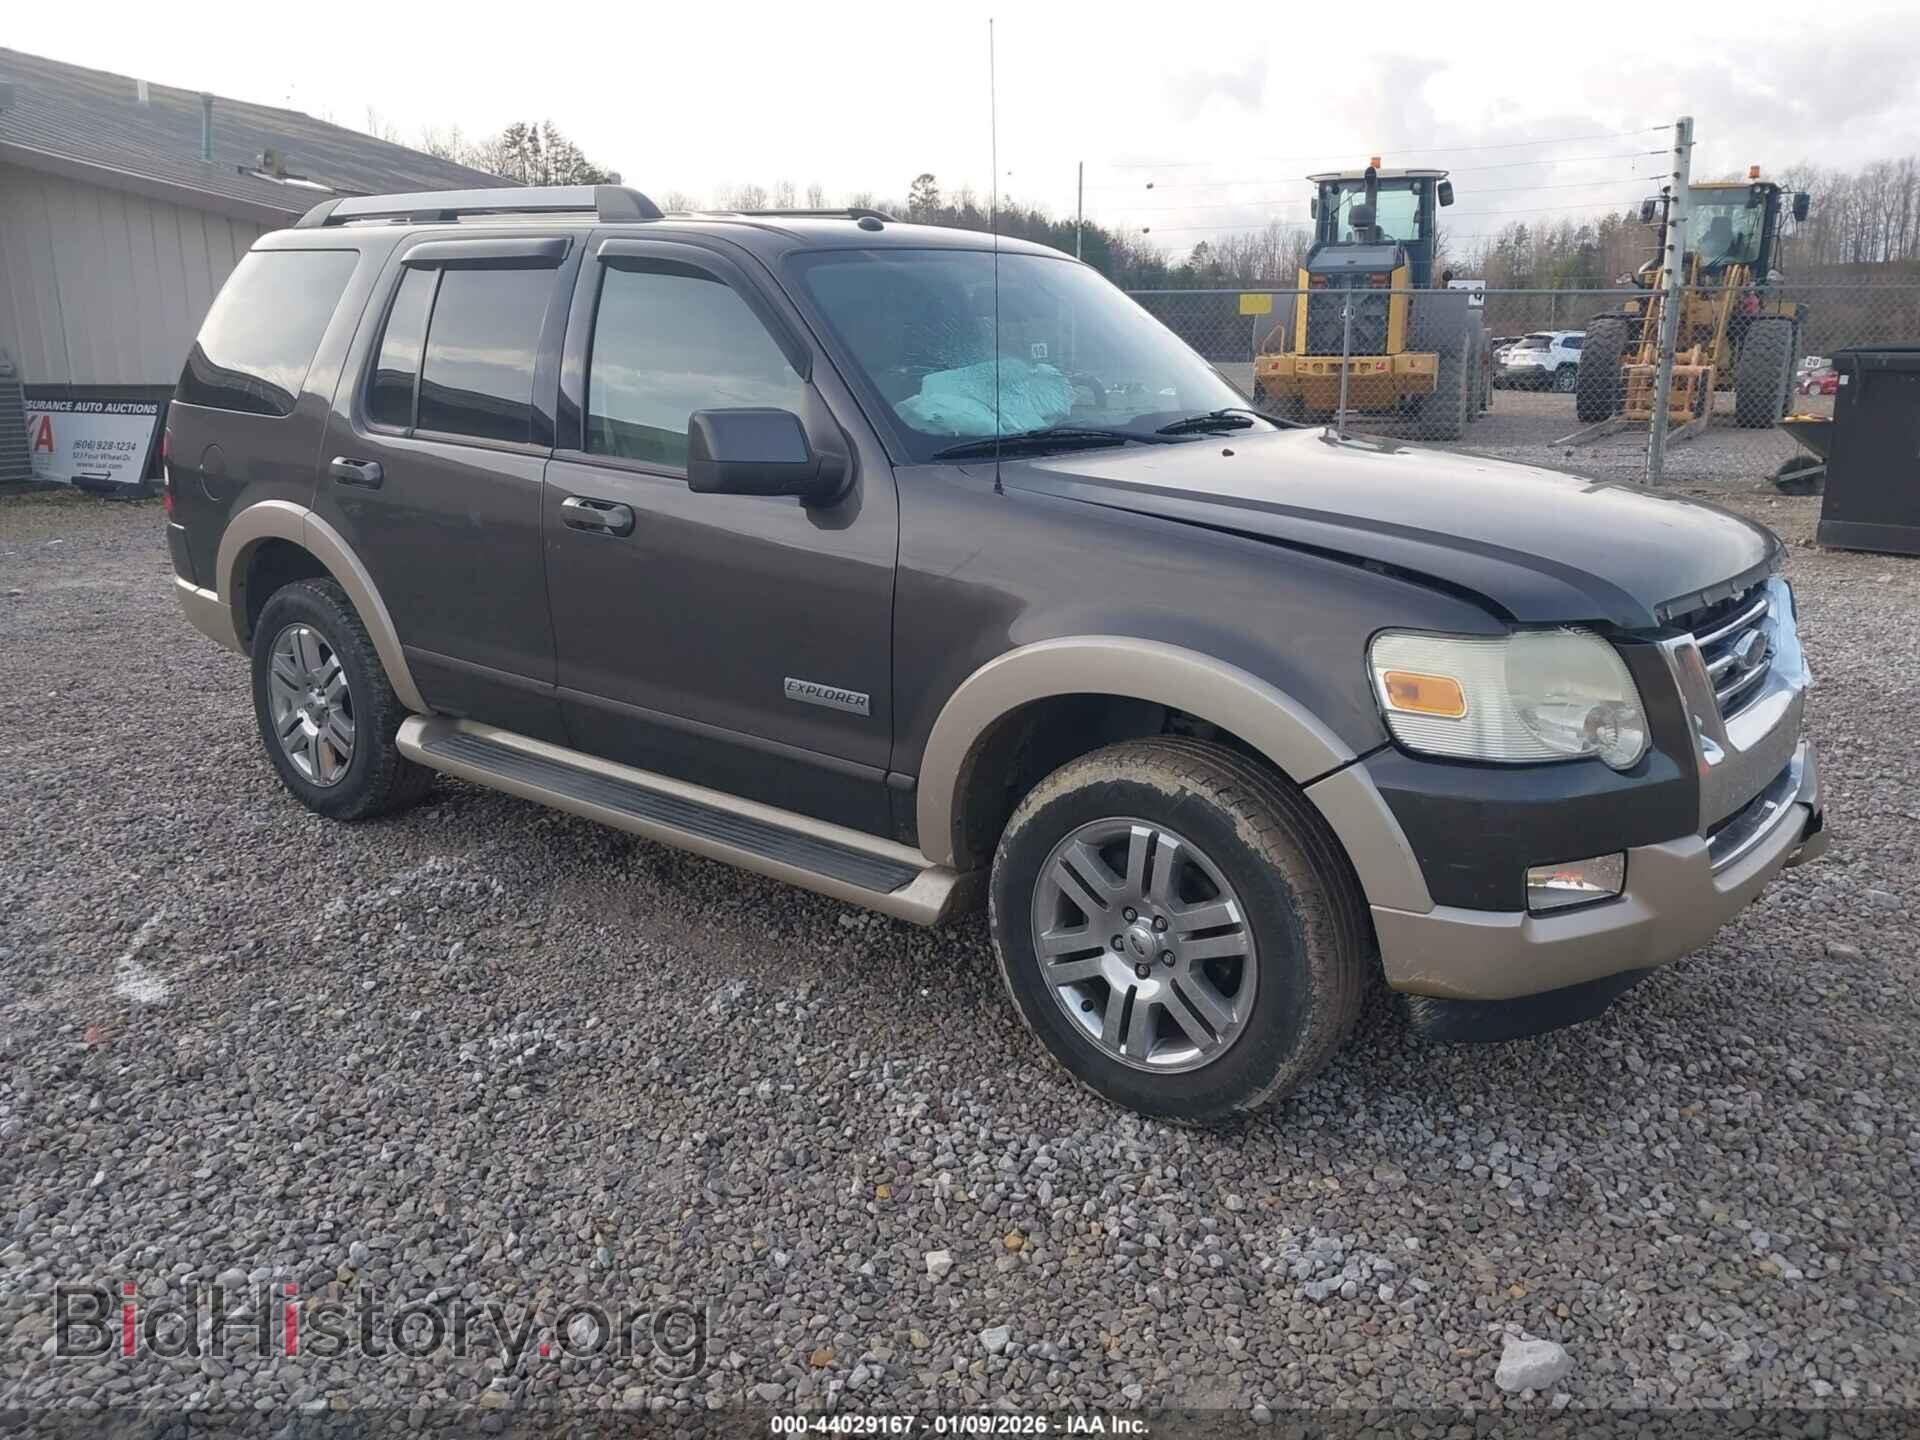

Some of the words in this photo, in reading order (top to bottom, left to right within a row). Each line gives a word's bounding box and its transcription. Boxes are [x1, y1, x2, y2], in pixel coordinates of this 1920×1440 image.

[74, 402, 103, 412] AUTO
[105, 403, 158, 414] AUCTIONS
[786, 680, 867, 706] EXPLORER
